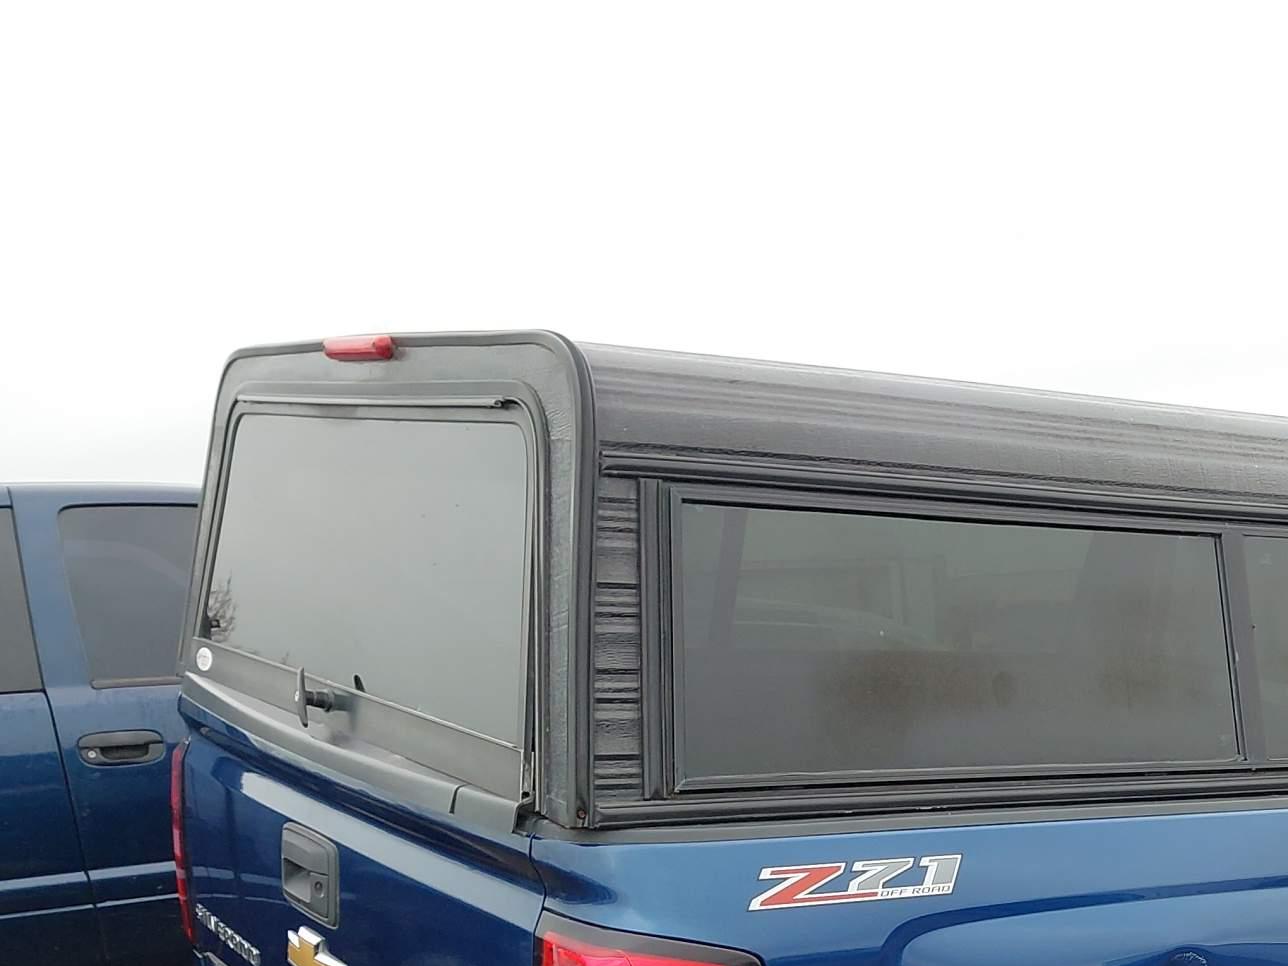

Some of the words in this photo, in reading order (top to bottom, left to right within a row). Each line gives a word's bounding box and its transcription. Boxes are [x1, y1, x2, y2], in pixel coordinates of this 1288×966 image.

[748, 853, 963, 912] Z71
[879, 887, 908, 898] OFF
[911, 884, 951, 897] ROAD
